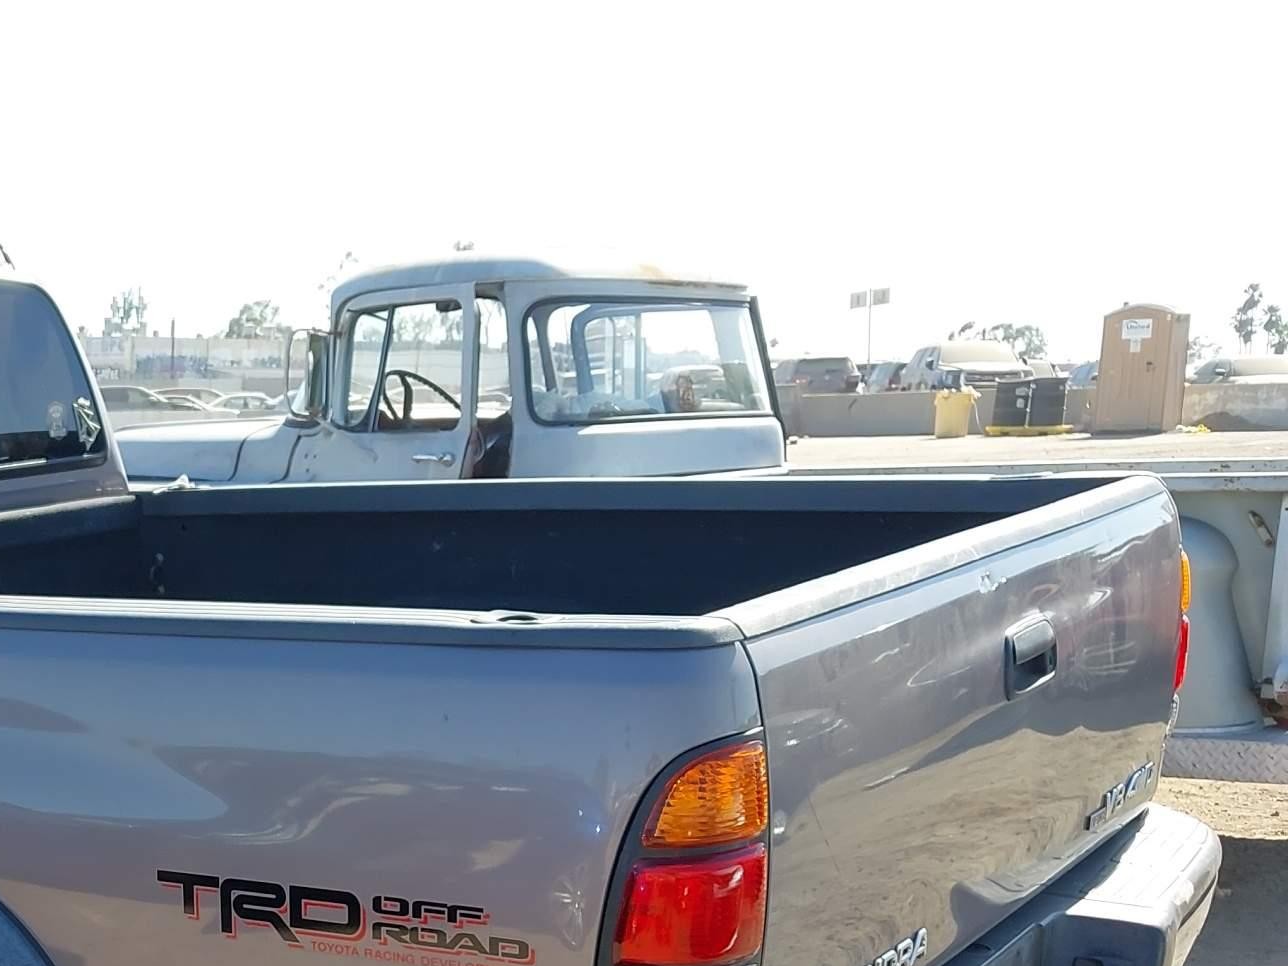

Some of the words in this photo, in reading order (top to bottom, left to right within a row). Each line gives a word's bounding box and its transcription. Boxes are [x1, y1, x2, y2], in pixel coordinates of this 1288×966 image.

[156, 868, 365, 947] TRD
[371, 895, 491, 929] OFF
[310, 939, 361, 958] TOYOTA
[364, 948, 415, 966] RACING
[371, 922, 535, 966] ROAD
